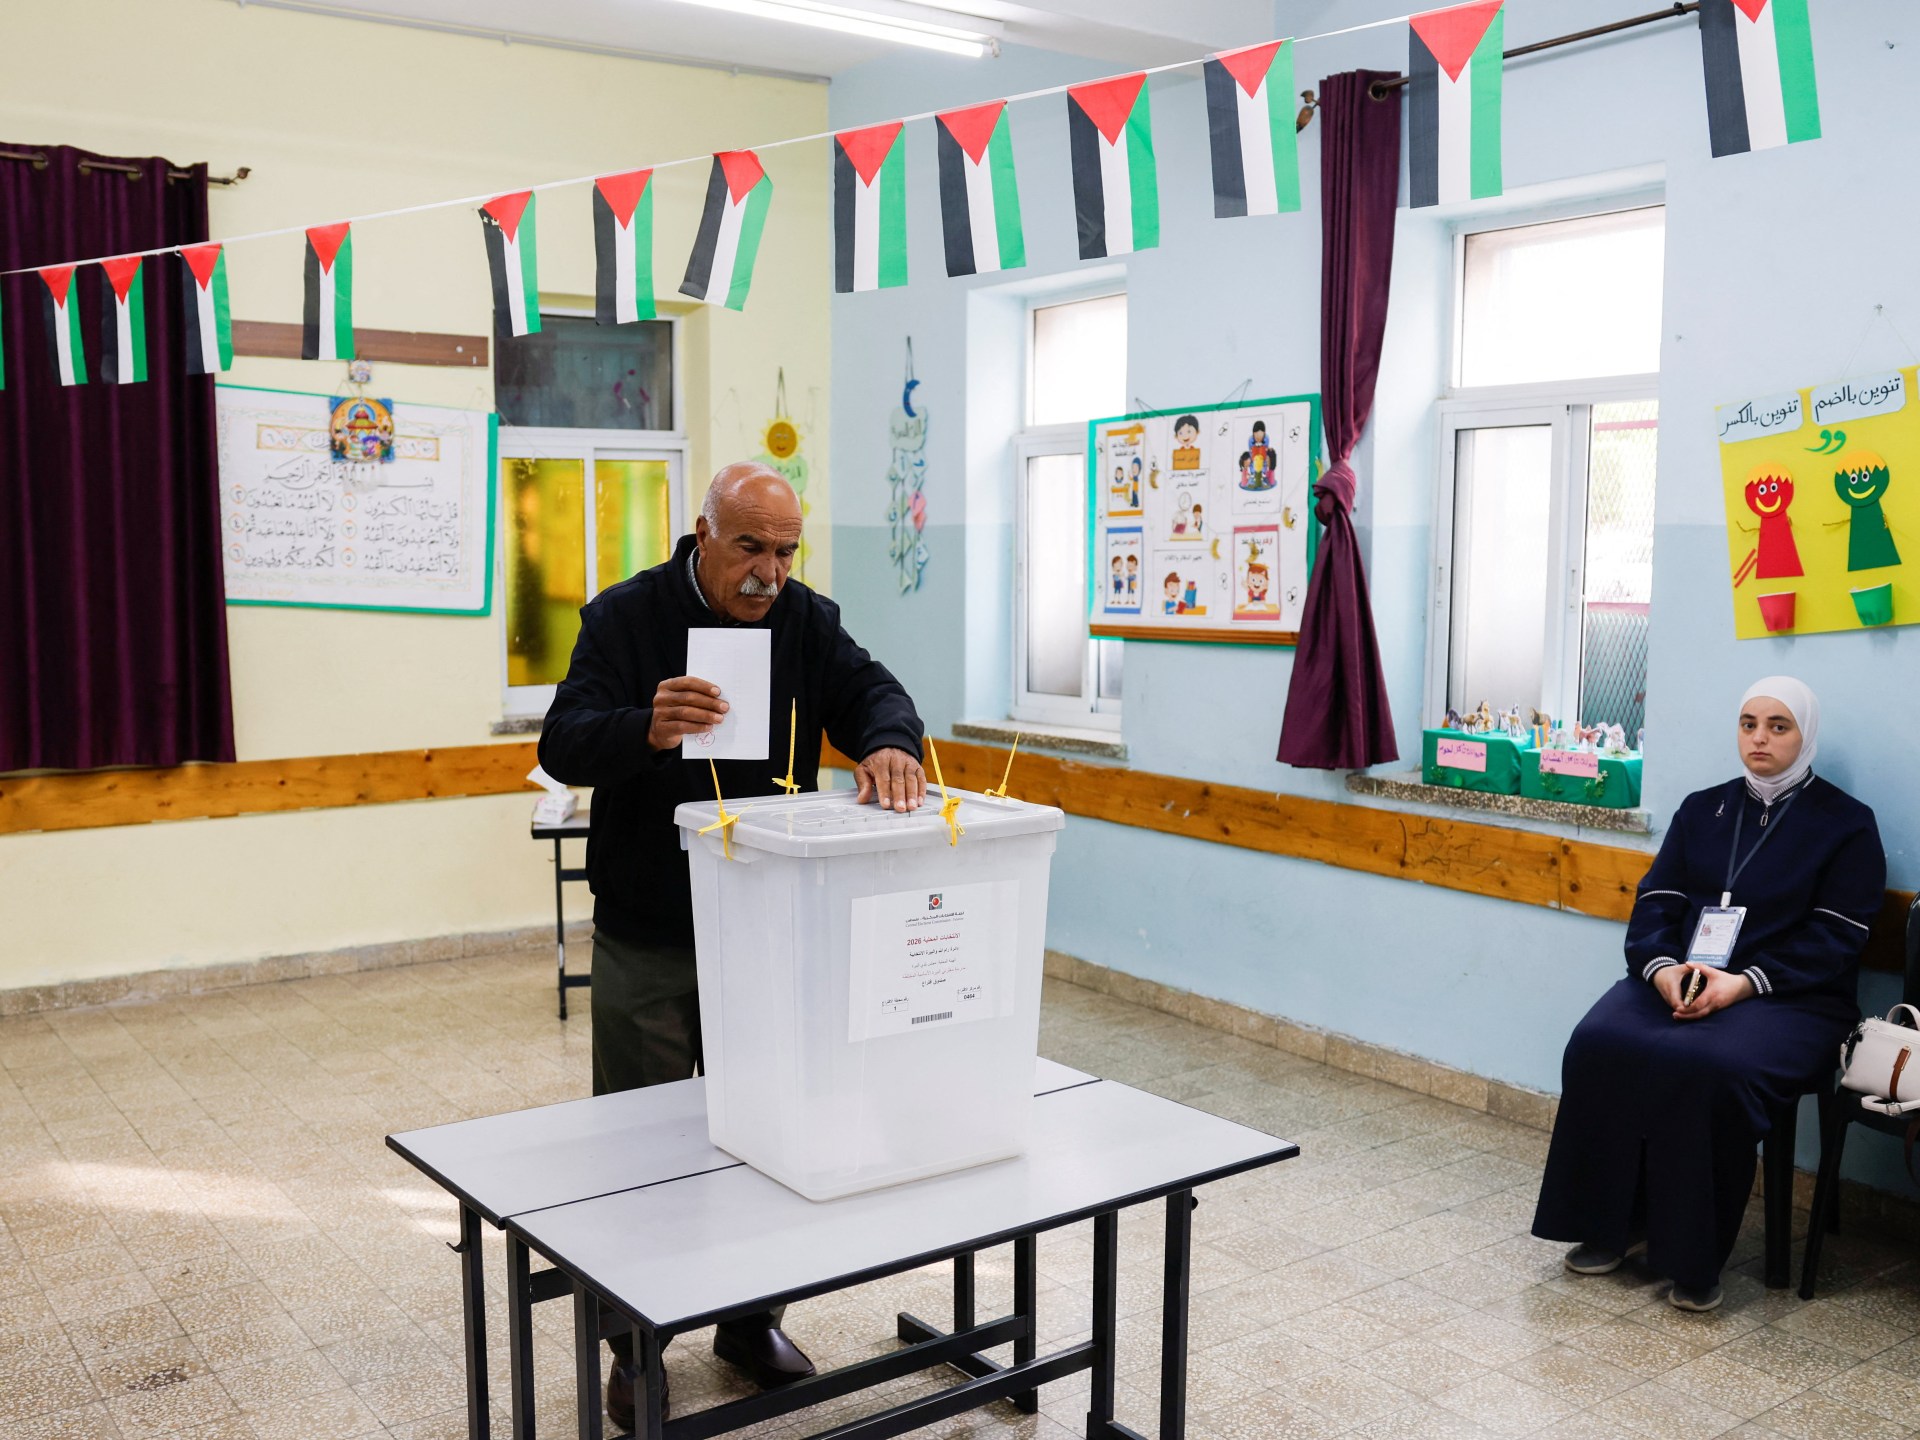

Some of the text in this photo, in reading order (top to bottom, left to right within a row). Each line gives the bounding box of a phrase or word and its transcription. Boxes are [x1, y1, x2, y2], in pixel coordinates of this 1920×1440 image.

[1719, 399, 1799, 437] تنوين بالكسر
[1814, 377, 1901, 422] تنوين بالضم
[906, 938, 922, 946] 2026
